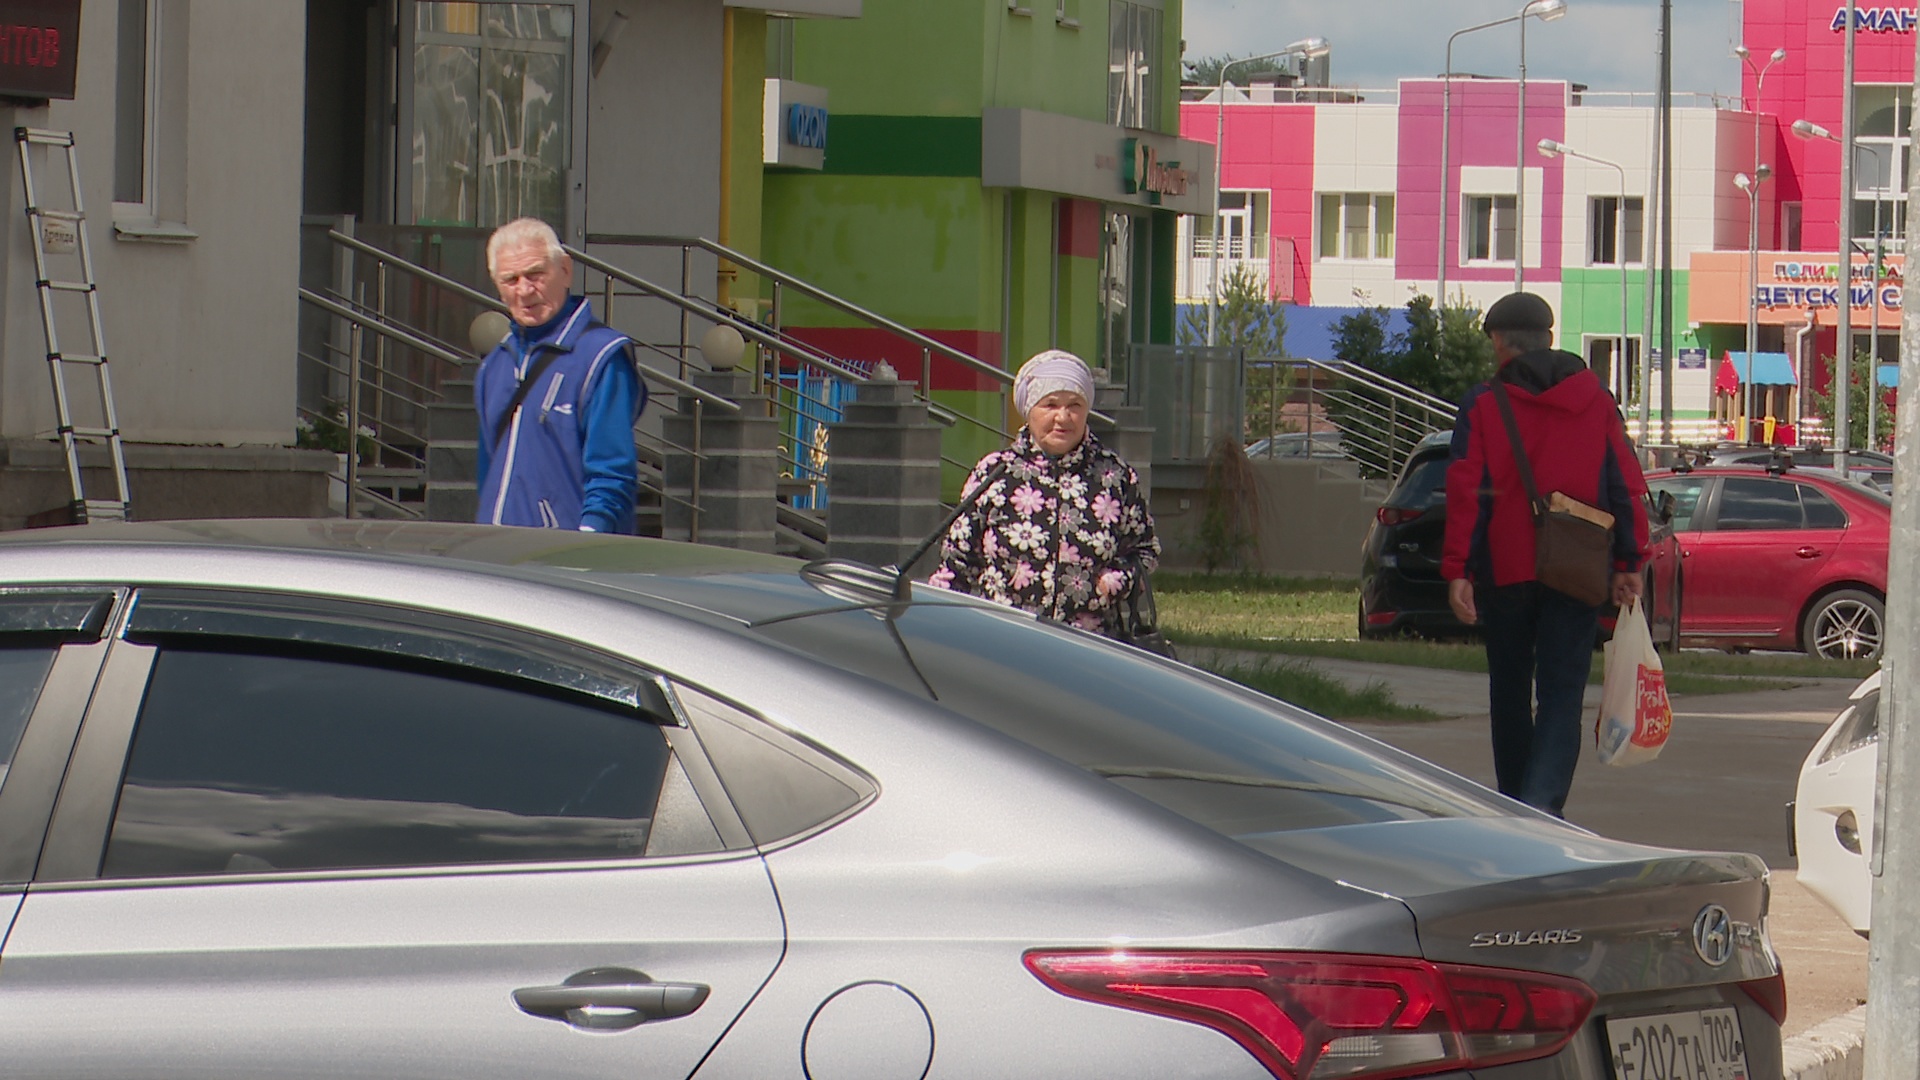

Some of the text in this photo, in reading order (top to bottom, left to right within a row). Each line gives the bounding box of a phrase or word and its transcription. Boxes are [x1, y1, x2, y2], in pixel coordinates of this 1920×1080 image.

[795, 104, 827, 149] OZON
[1881, 287, 1903, 306] С
[1469, 929, 1582, 947] SOLARIS
[1703, 1015, 1739, 1064] 702
